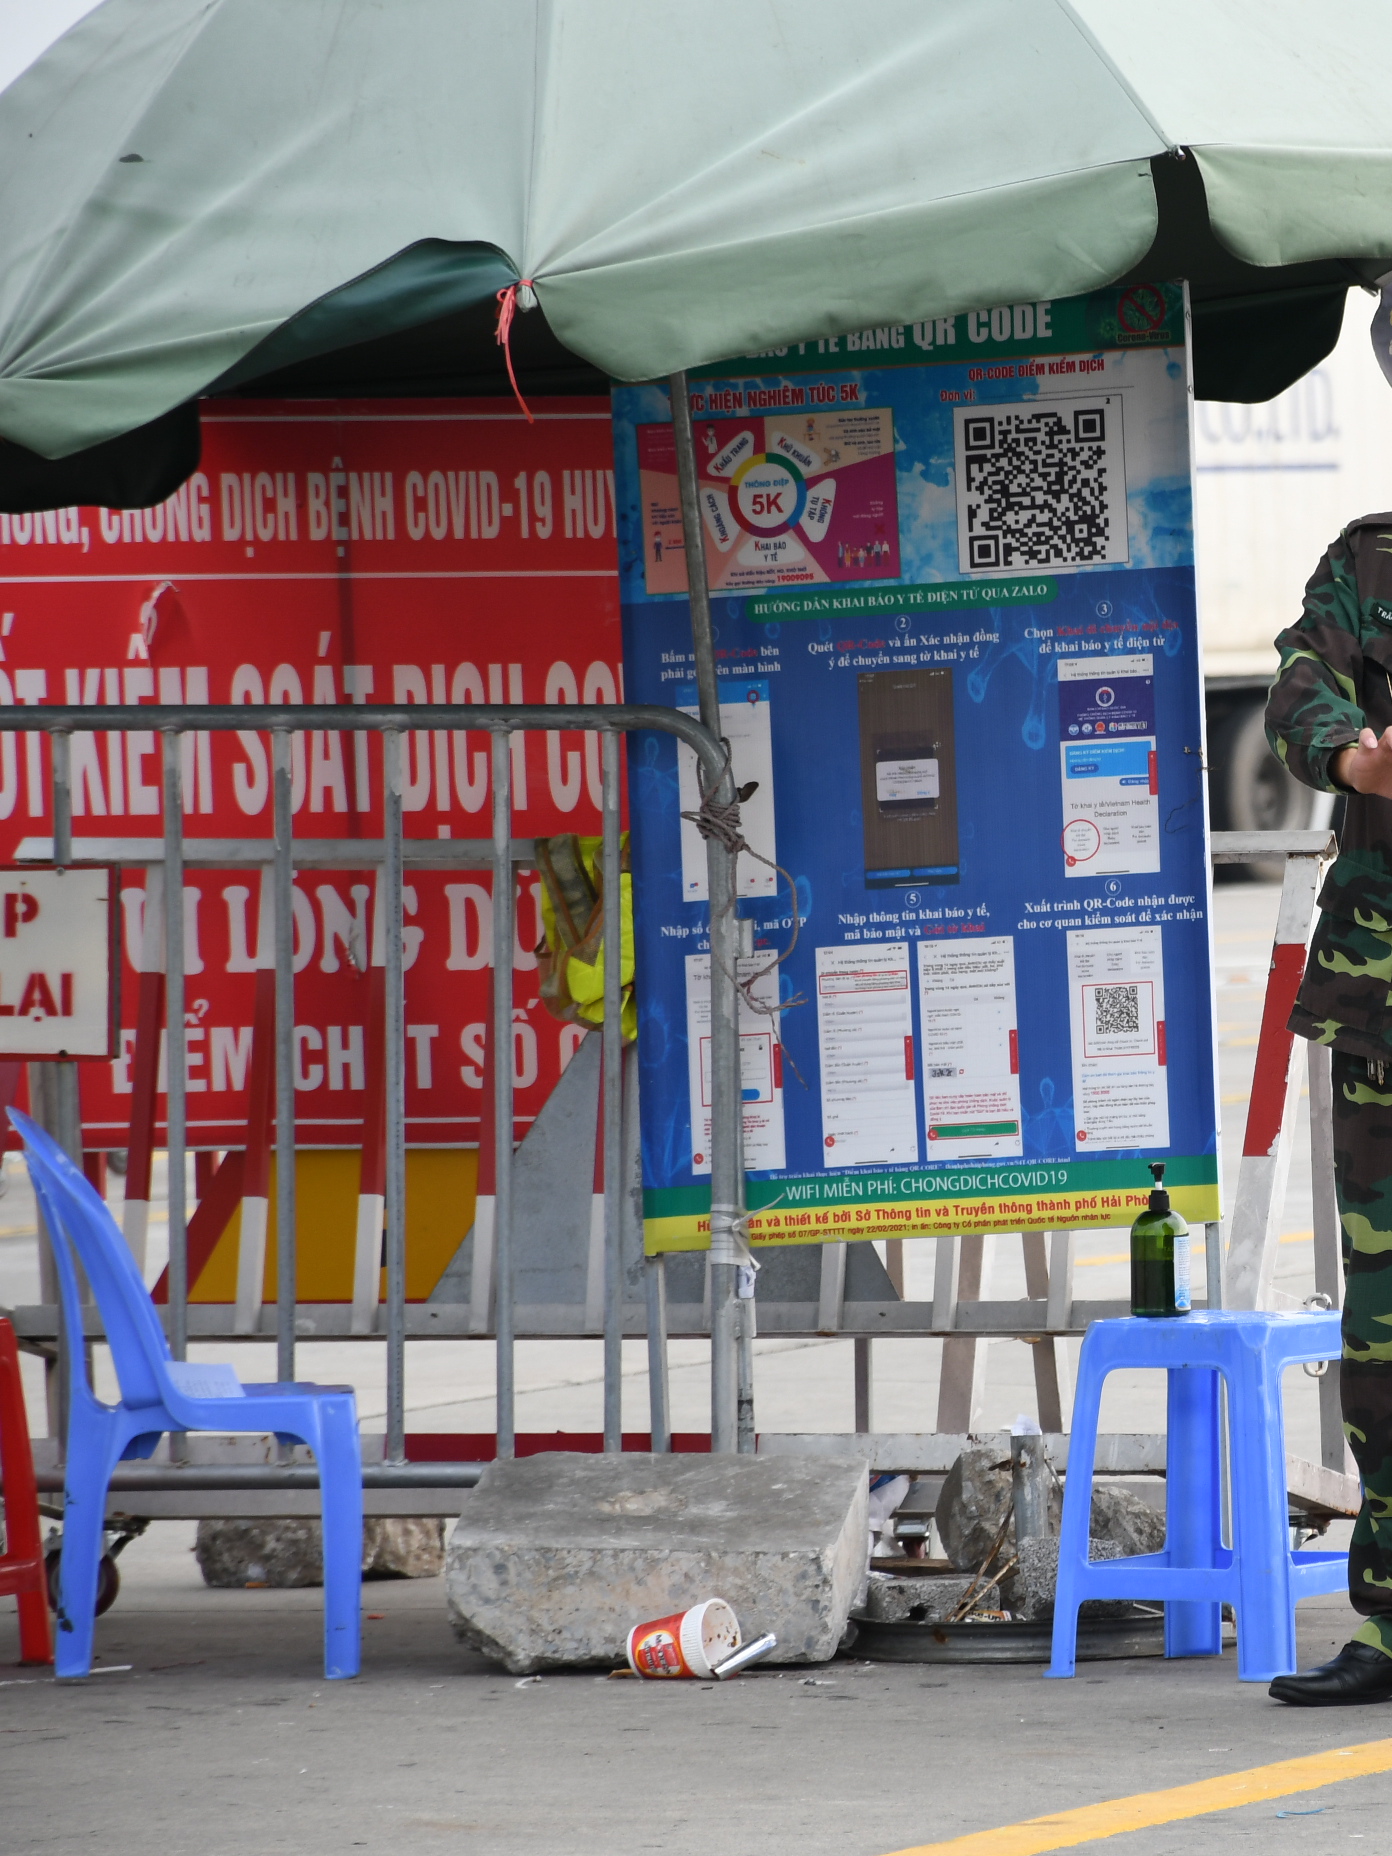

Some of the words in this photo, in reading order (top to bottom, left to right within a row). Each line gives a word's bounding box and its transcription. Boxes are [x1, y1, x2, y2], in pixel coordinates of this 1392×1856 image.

[912, 314, 956, 352] QR
[967, 300, 1054, 344] CODE
[968, 367, 1015, 382] QR-CODE
[1018, 359, 1046, 378] ĐIỂM
[1048, 357, 1077, 377] KIỂM
[1079, 358, 1106, 376] DỊCH
[709, 388, 743, 414] HIỆN
[747, 385, 805, 409] NGHIÊM
[808, 382, 837, 404] TÚC
[840, 383, 860, 402] 5K
[940, 389, 960, 402] Đơn
[744, 478, 771, 489] THÔNG
[220, 472, 297, 558] DỊCH
[307, 455, 395, 558] BỆNH
[406, 469, 553, 541] COVID-19
[751, 491, 784, 517] 5K
[754, 540, 771, 552] KHAI
[772, 541, 788, 552] BÁO
[754, 600, 801, 615] HƯỚNG
[804, 596, 830, 611] DẪN
[833, 596, 865, 610] KHAI
[868, 591, 895, 607] BÁO
[897, 594, 906, 605] Y
[907, 589, 924, 604] TẾ
[927, 589, 958, 605] ĐIỆN
[982, 586, 1009, 600] QUA
[1012, 584, 1048, 597] ZALO
[807, 641, 834, 655] Quét
[888, 637, 901, 648] và
[904, 633, 917, 647] ấn
[919, 633, 941, 647] Xác
[943, 631, 970, 646] nhận
[972, 627, 1000, 643] đồng
[1024, 626, 1053, 640] Chọn
[1038, 640, 1052, 654] để
[1055, 639, 1079, 653] khai
[1081, 637, 1101, 651] báo
[1104, 641, 1111, 653] y
[1113, 634, 1124, 649] tế
[1126, 636, 1150, 650] điện
[661, 650, 685, 664] Bấm
[760, 645, 780, 657] bên
[837, 652, 851, 667] để
[852, 650, 890, 668] chuyển
[892, 653, 918, 666] sang
[919, 650, 931, 662] tờ
[933, 648, 957, 661] khai
[969, 644, 980, 659] tế
[660, 667, 684, 682] phải
[732, 663, 755, 675] màn
[757, 661, 781, 673] hình
[231, 630, 374, 816] SOÁT
[1024, 898, 1051, 914] Xuất
[1053, 897, 1081, 912] trình
[1083, 896, 1135, 911] QR-Code
[1137, 894, 1165, 909] nhận
[1168, 893, 1196, 905] được
[660, 924, 690, 939] Nhập
[692, 920, 704, 934] số
[763, 917, 780, 930] mã
[838, 911, 867, 927] Nhập
[869, 910, 900, 924] thông
[902, 909, 917, 921] tin
[919, 908, 943, 920] khai
[945, 906, 965, 919] báo
[967, 908, 974, 919] y
[1017, 917, 1037, 930] cho
[1039, 918, 1053, 929] cơ
[1054, 918, 1082, 930] quan
[1084, 909, 1112, 925] kiểm
[1114, 912, 1137, 924] soát
[1138, 908, 1152, 922] để
[1154, 910, 1173, 922] xác
[1176, 908, 1204, 923] nhận
[844, 928, 861, 940] mã
[863, 926, 883, 939] bảo
[885, 925, 906, 939] mật
[908, 925, 921, 936] và
[961, 921, 986, 934] khai
[293, 1001, 439, 1092] CHT
[460, 998, 539, 1090] SỐ
[786, 1185, 820, 1201] WIFI
[823, 1177, 863, 1199] MIỄN
[867, 1175, 897, 1197] PHÍ:
[901, 1170, 1068, 1194] CHONGDICHCOVID19
[766, 1214, 781, 1227] và
[785, 1211, 812, 1226] thiết
[815, 1210, 829, 1224] kế
[833, 1210, 852, 1223] bởi
[856, 1208, 872, 1222] Sở
[875, 1207, 912, 1222] Thông
[916, 1206, 932, 1219] tin
[935, 1206, 950, 1218] và
[952, 1202, 995, 1219] Truyền
[999, 1200, 1033, 1215] thông
[1036, 1198, 1070, 1213] thành
[1075, 1195, 1098, 1212] phố
[1101, 1195, 1122, 1209] Hải
[769, 1230, 786, 1241] phép
[933, 1220, 952, 1230] Công
[962, 1218, 972, 1228] Cổ
[1027, 1215, 1046, 1225] Quốc
[1057, 1213, 1079, 1224] Nguồn
